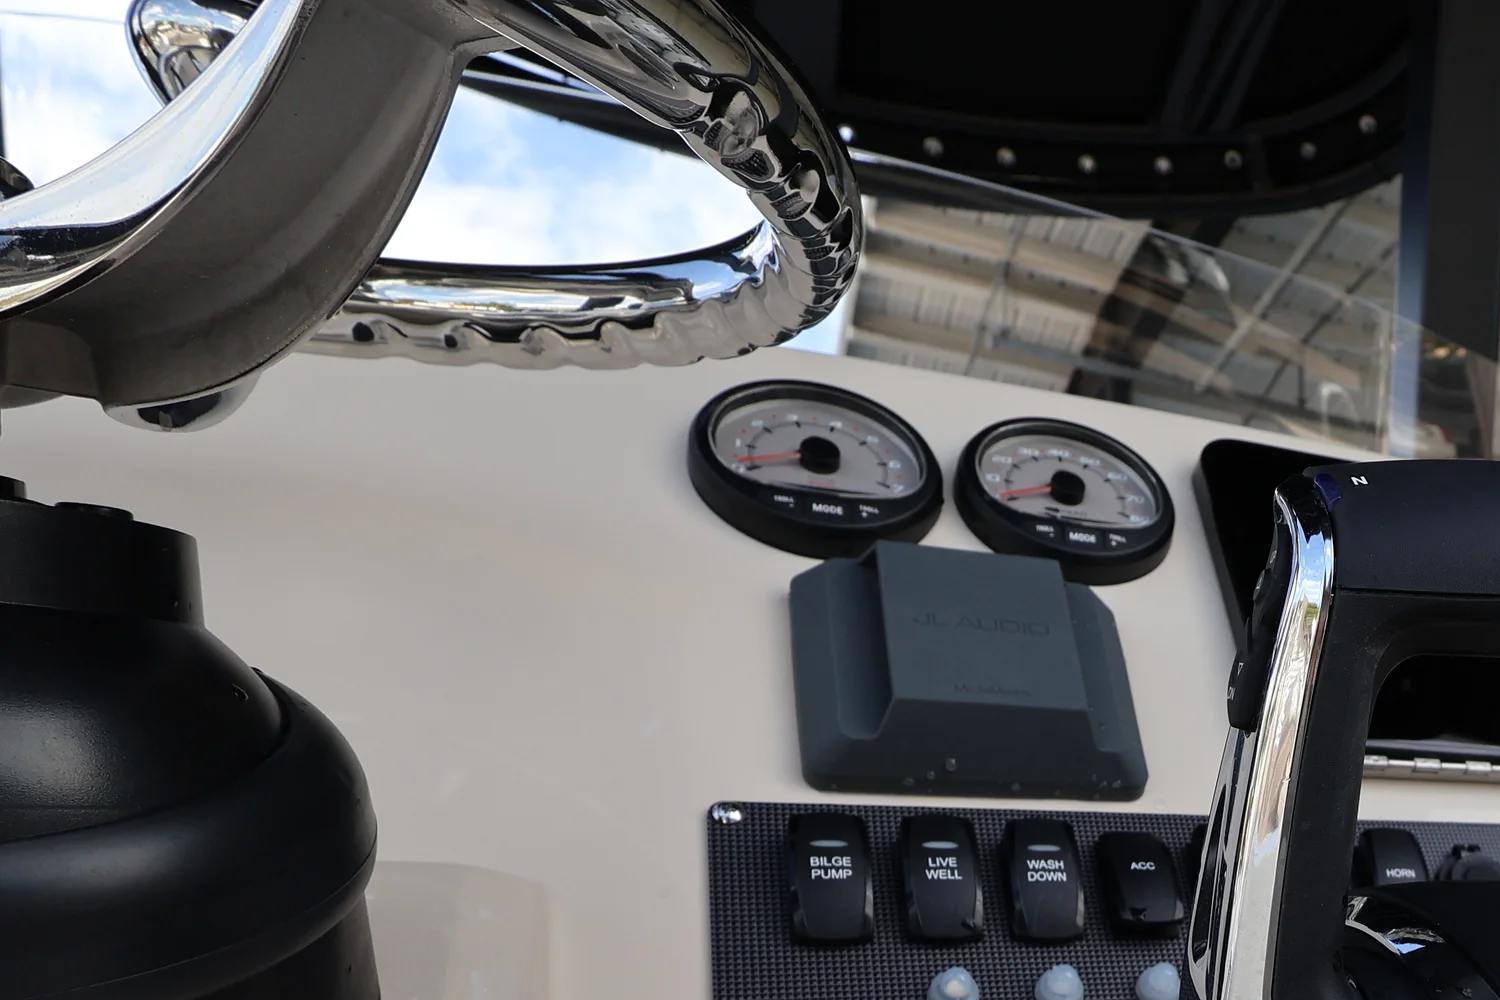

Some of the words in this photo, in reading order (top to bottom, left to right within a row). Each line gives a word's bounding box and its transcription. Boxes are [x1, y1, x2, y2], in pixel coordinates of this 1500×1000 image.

[1351, 476, 1368, 485] N
[812, 502, 844, 515] MODE
[1069, 531, 1097, 544] MODE
[913, 612, 947, 627] JL
[955, 614, 1050, 636] AUDIO
[810, 856, 852, 869] BILGE
[928, 856, 958, 868] LIVE
[1027, 859, 1065, 871] WASH
[1130, 861, 1156, 871] ACC
[811, 868, 853, 881] PUMP
[925, 868, 963, 881] WELL
[1027, 870, 1067, 883] DOWN
[1386, 868, 1416, 879] HORN
